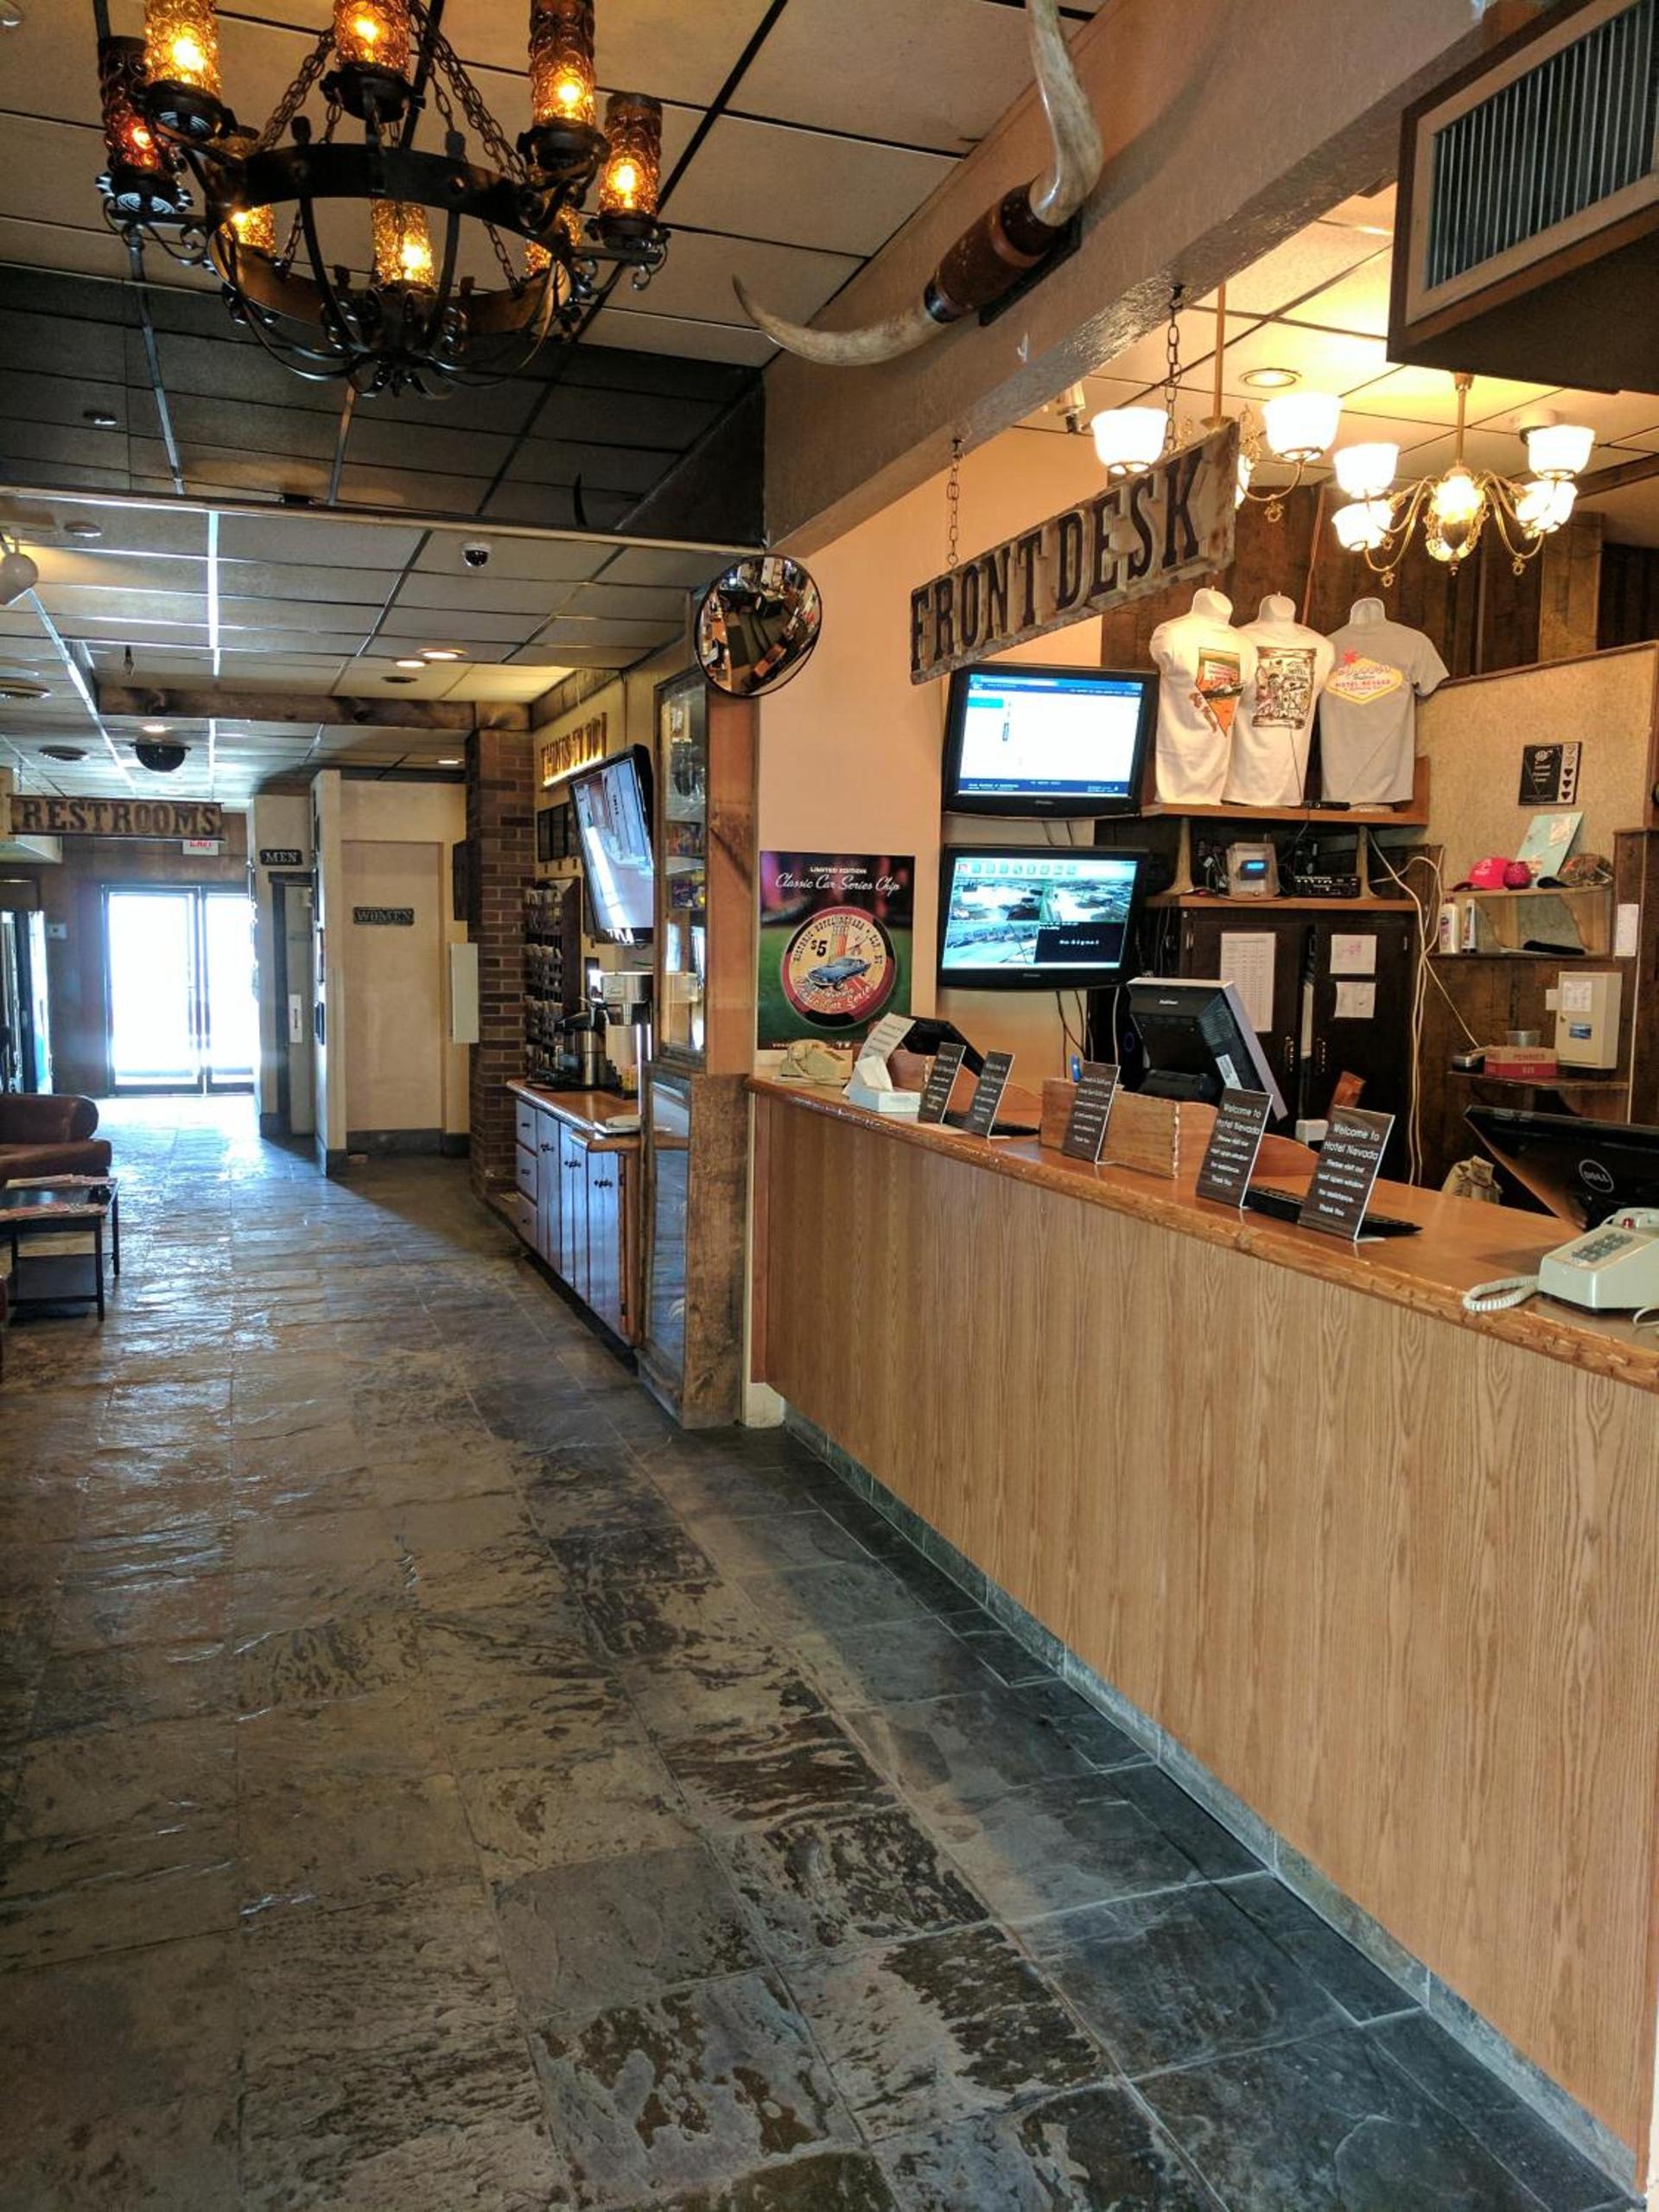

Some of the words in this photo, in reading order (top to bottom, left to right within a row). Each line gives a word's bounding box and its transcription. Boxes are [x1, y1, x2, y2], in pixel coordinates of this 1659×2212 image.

[912, 529, 1045, 674] FRONT
[1057, 447, 1205, 612] DESK
[20, 799, 217, 836] RESTROOMS
[264, 851, 298, 863] MEN
[775, 872, 813, 889] Classic
[816, 874, 836, 889] Car
[838, 874, 873, 890] Series
[875, 875, 900, 897] Chip
[356, 910, 412, 922] WOMEN
[810, 938, 828, 957] $5
[1334, 1122, 1369, 1140] Welcome
[1324, 1141, 1345, 1153] Hotel
[1346, 1145, 1379, 1160] Nevada
[1583, 1171, 1610, 1183] DELL
